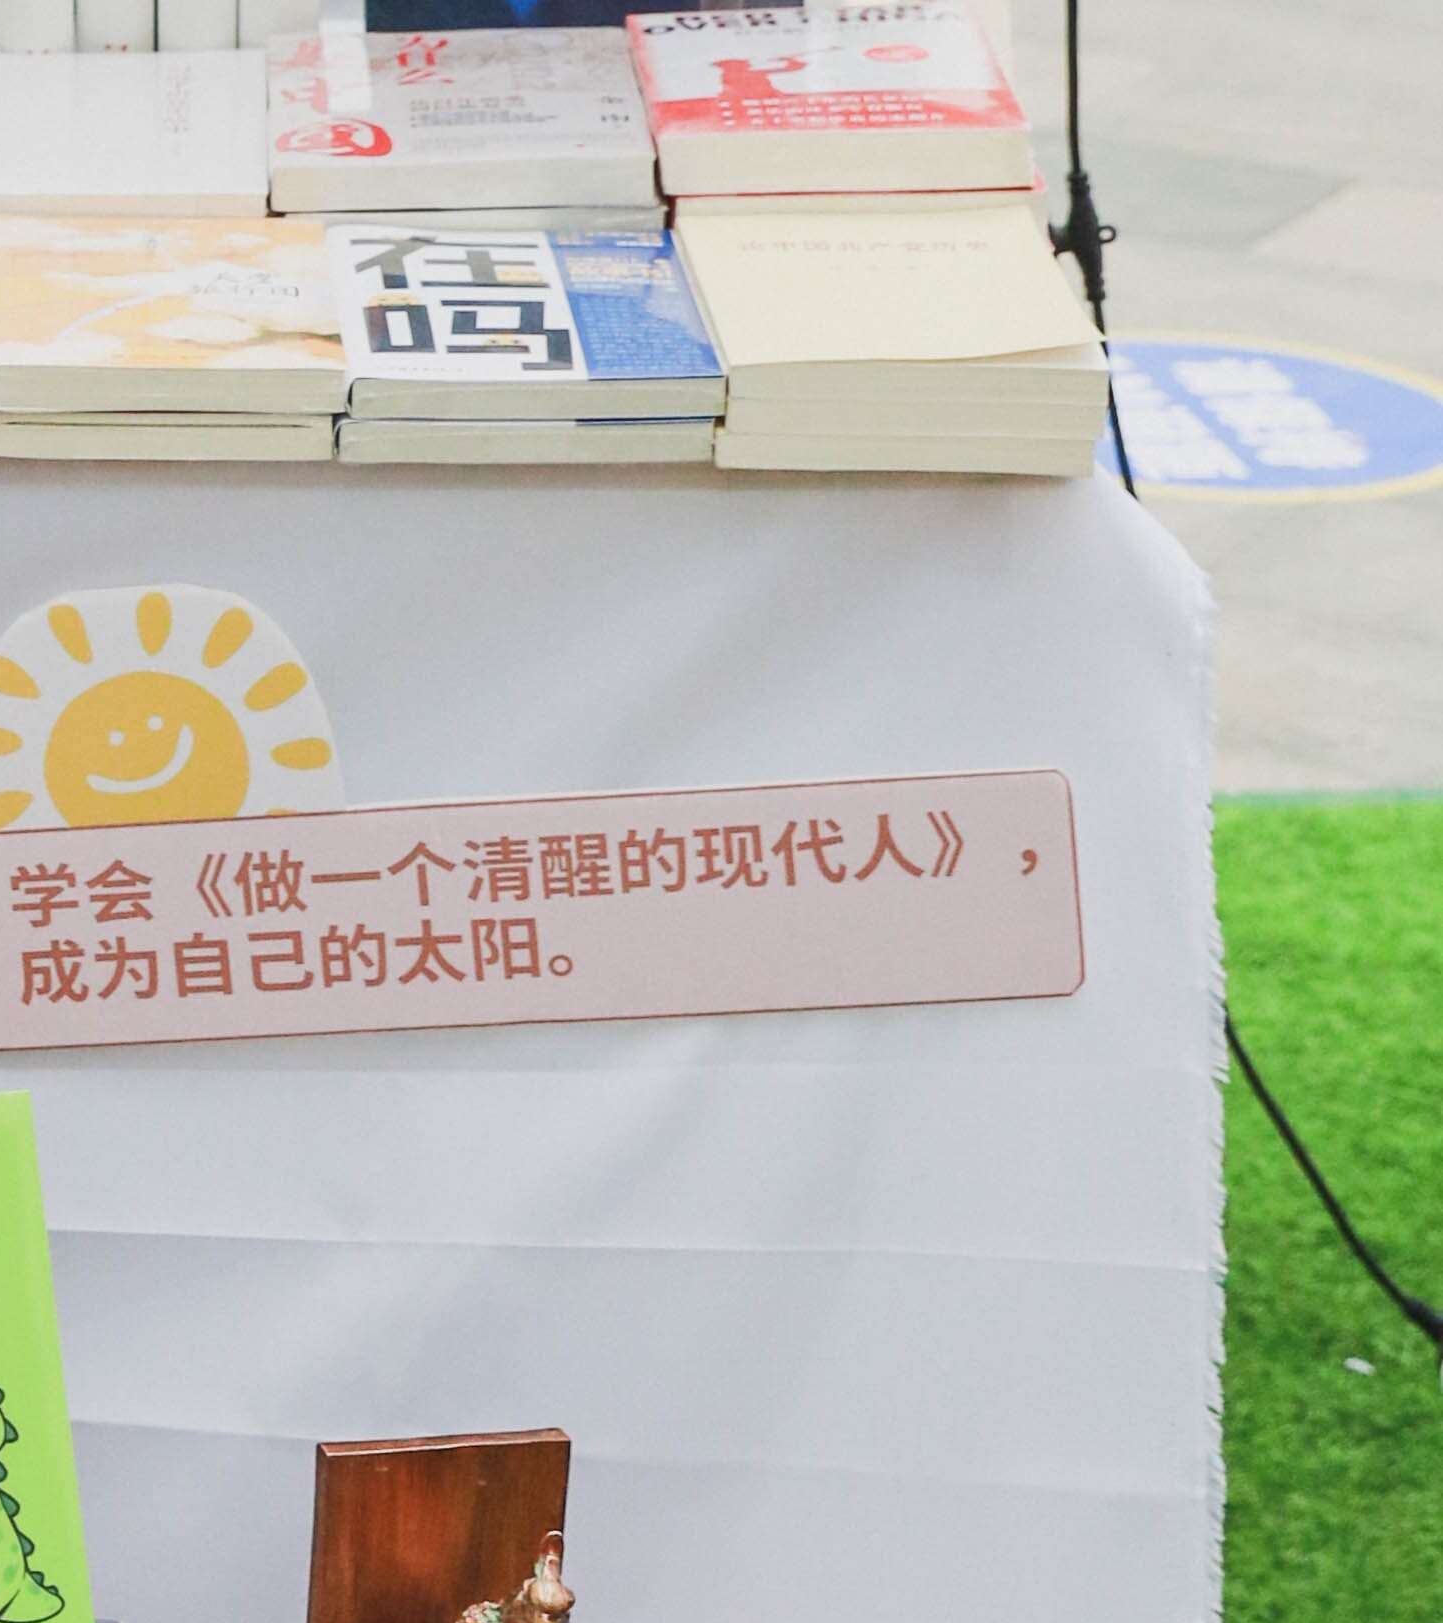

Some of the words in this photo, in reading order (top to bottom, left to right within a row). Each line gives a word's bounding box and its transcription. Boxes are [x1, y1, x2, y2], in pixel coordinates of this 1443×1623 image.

[20, 921, 580, 1009] 成为自己的太阳。
